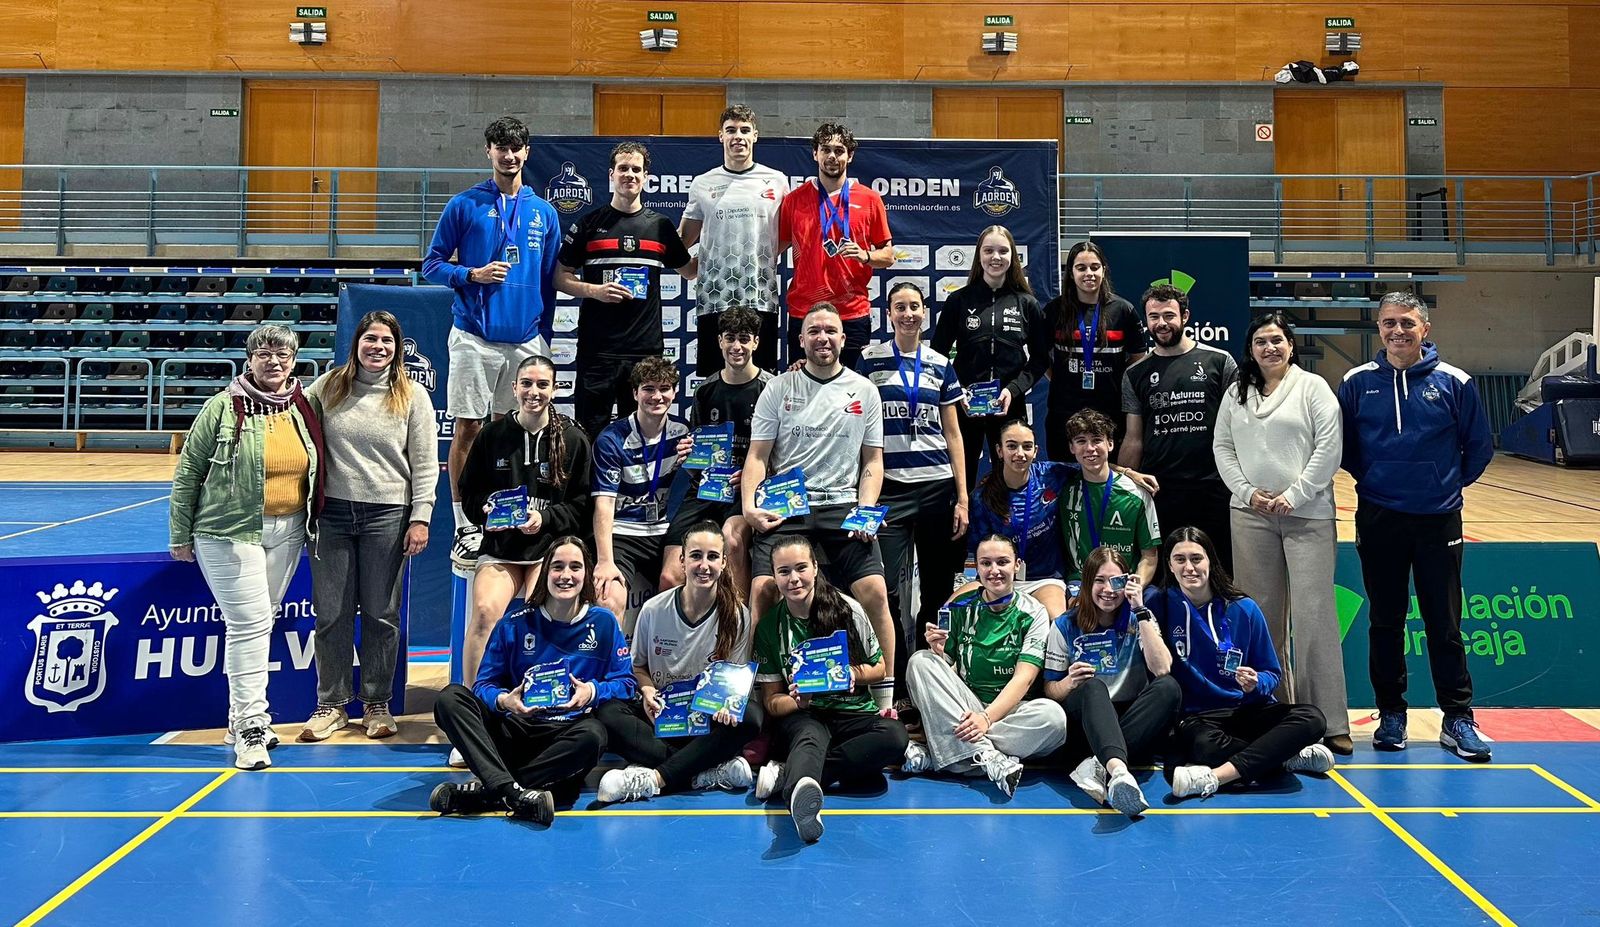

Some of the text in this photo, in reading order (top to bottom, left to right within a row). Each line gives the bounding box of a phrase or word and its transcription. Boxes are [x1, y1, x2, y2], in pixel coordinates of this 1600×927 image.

[298, 8, 324, 16] SALIDA
[650, 12, 674, 20] SALIDA
[1327, 19, 1352, 27] SALIDA
[871, 178, 960, 197] ORDEN
[547, 188, 591, 203] LAORDEN
[975, 190, 1019, 206] LAORDEN
[884, 203, 961, 212] dmintonlaorden.es
[1170, 391, 1205, 401] Asturias
[1170, 424, 1208, 433] carné joven
[34, 635, 48, 685] PORTUS MARIS
[91, 640, 101, 674] CUSTODIA
